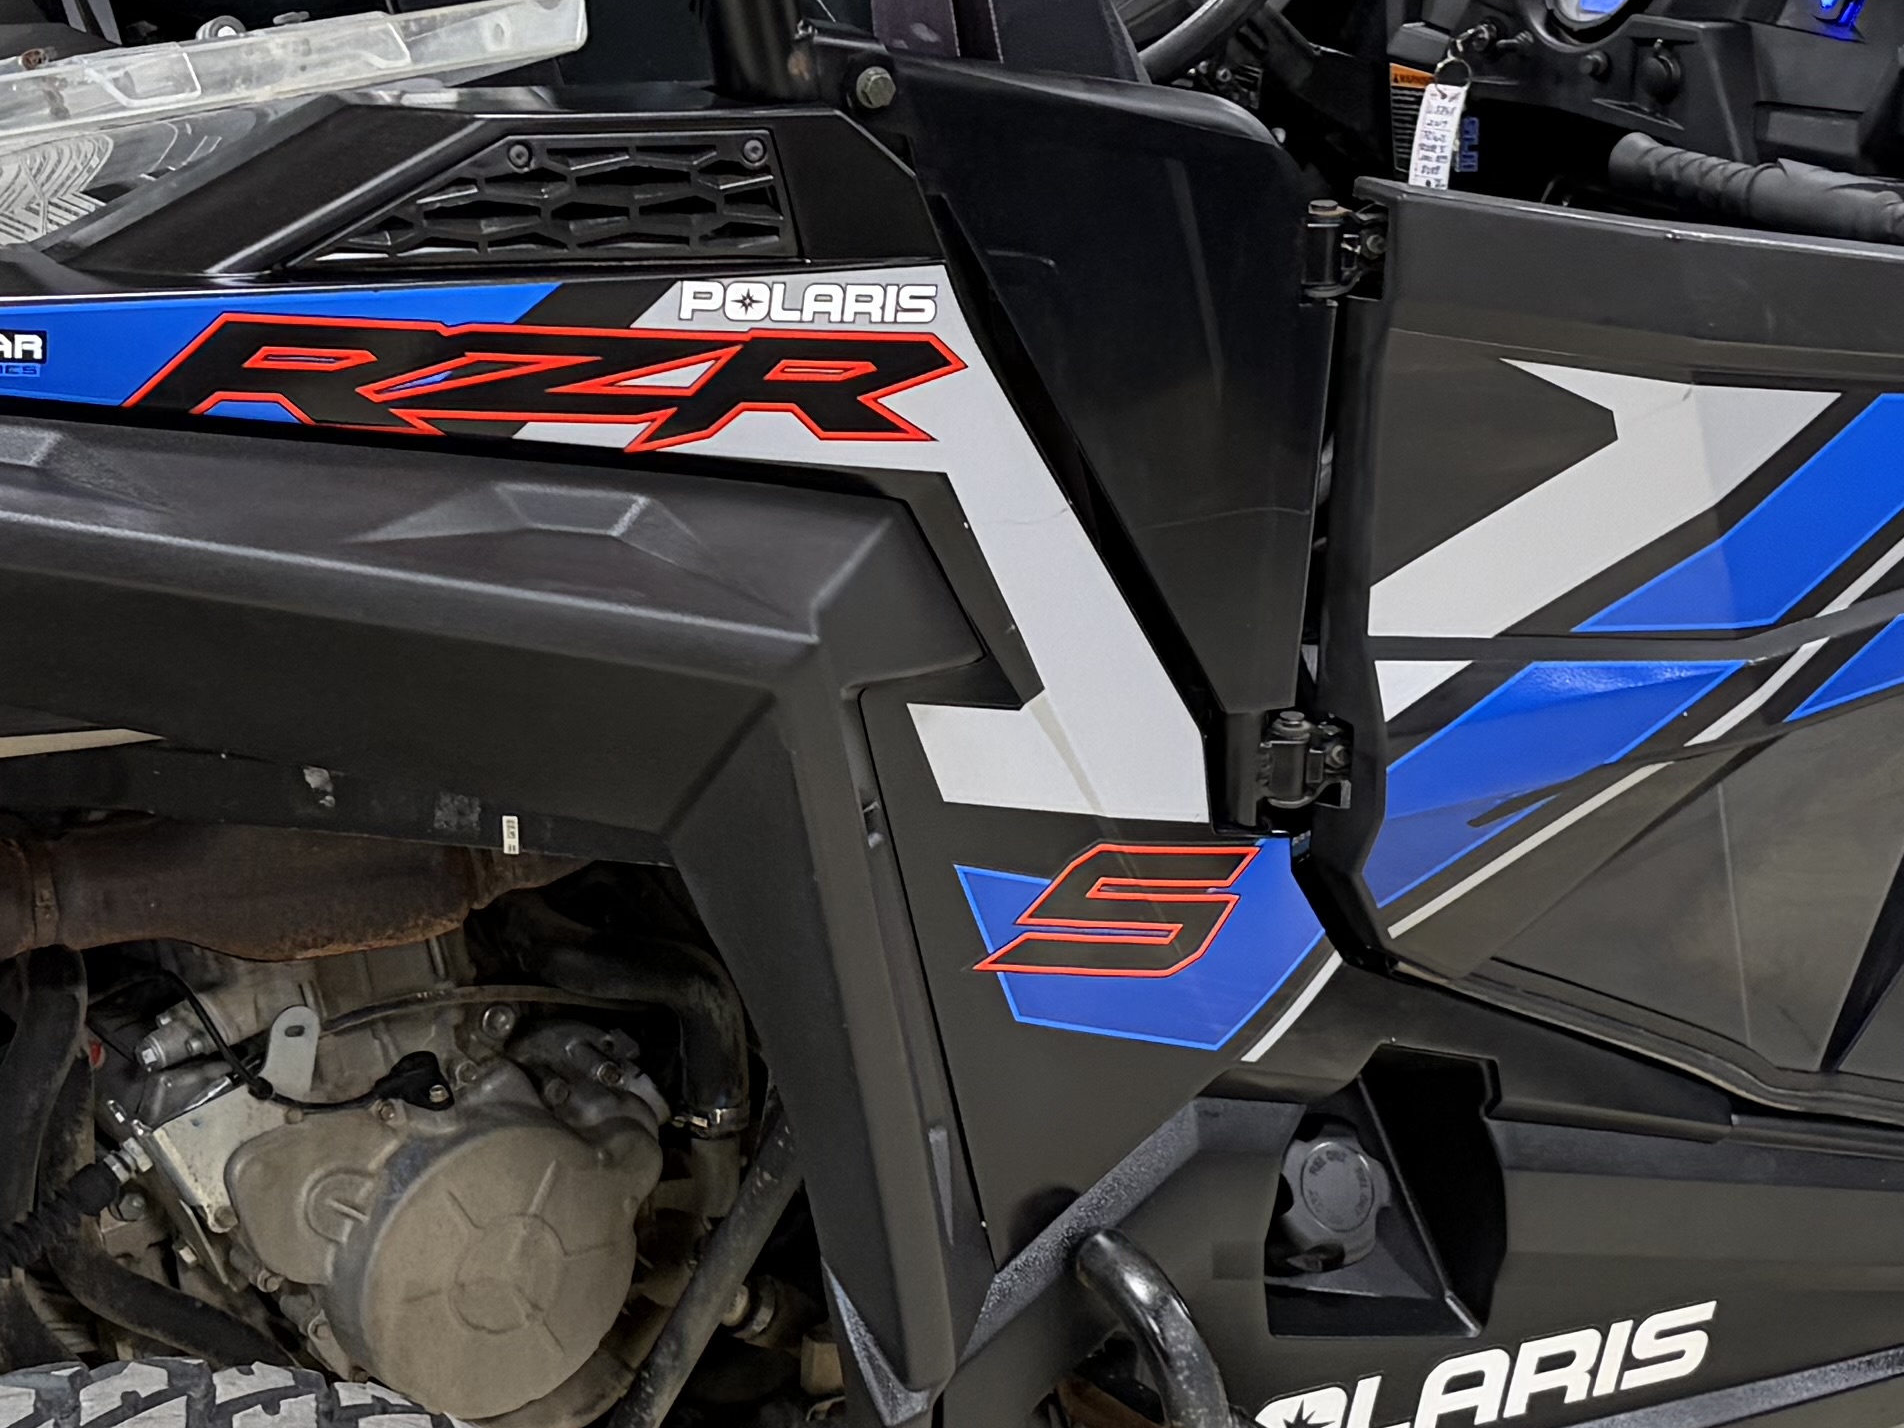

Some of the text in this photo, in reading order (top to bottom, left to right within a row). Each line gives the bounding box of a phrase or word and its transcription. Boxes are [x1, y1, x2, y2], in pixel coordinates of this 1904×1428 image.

[680, 280, 938, 324] POLARIS
[120, 312, 967, 453] RZR
[973, 843, 1261, 978] S
